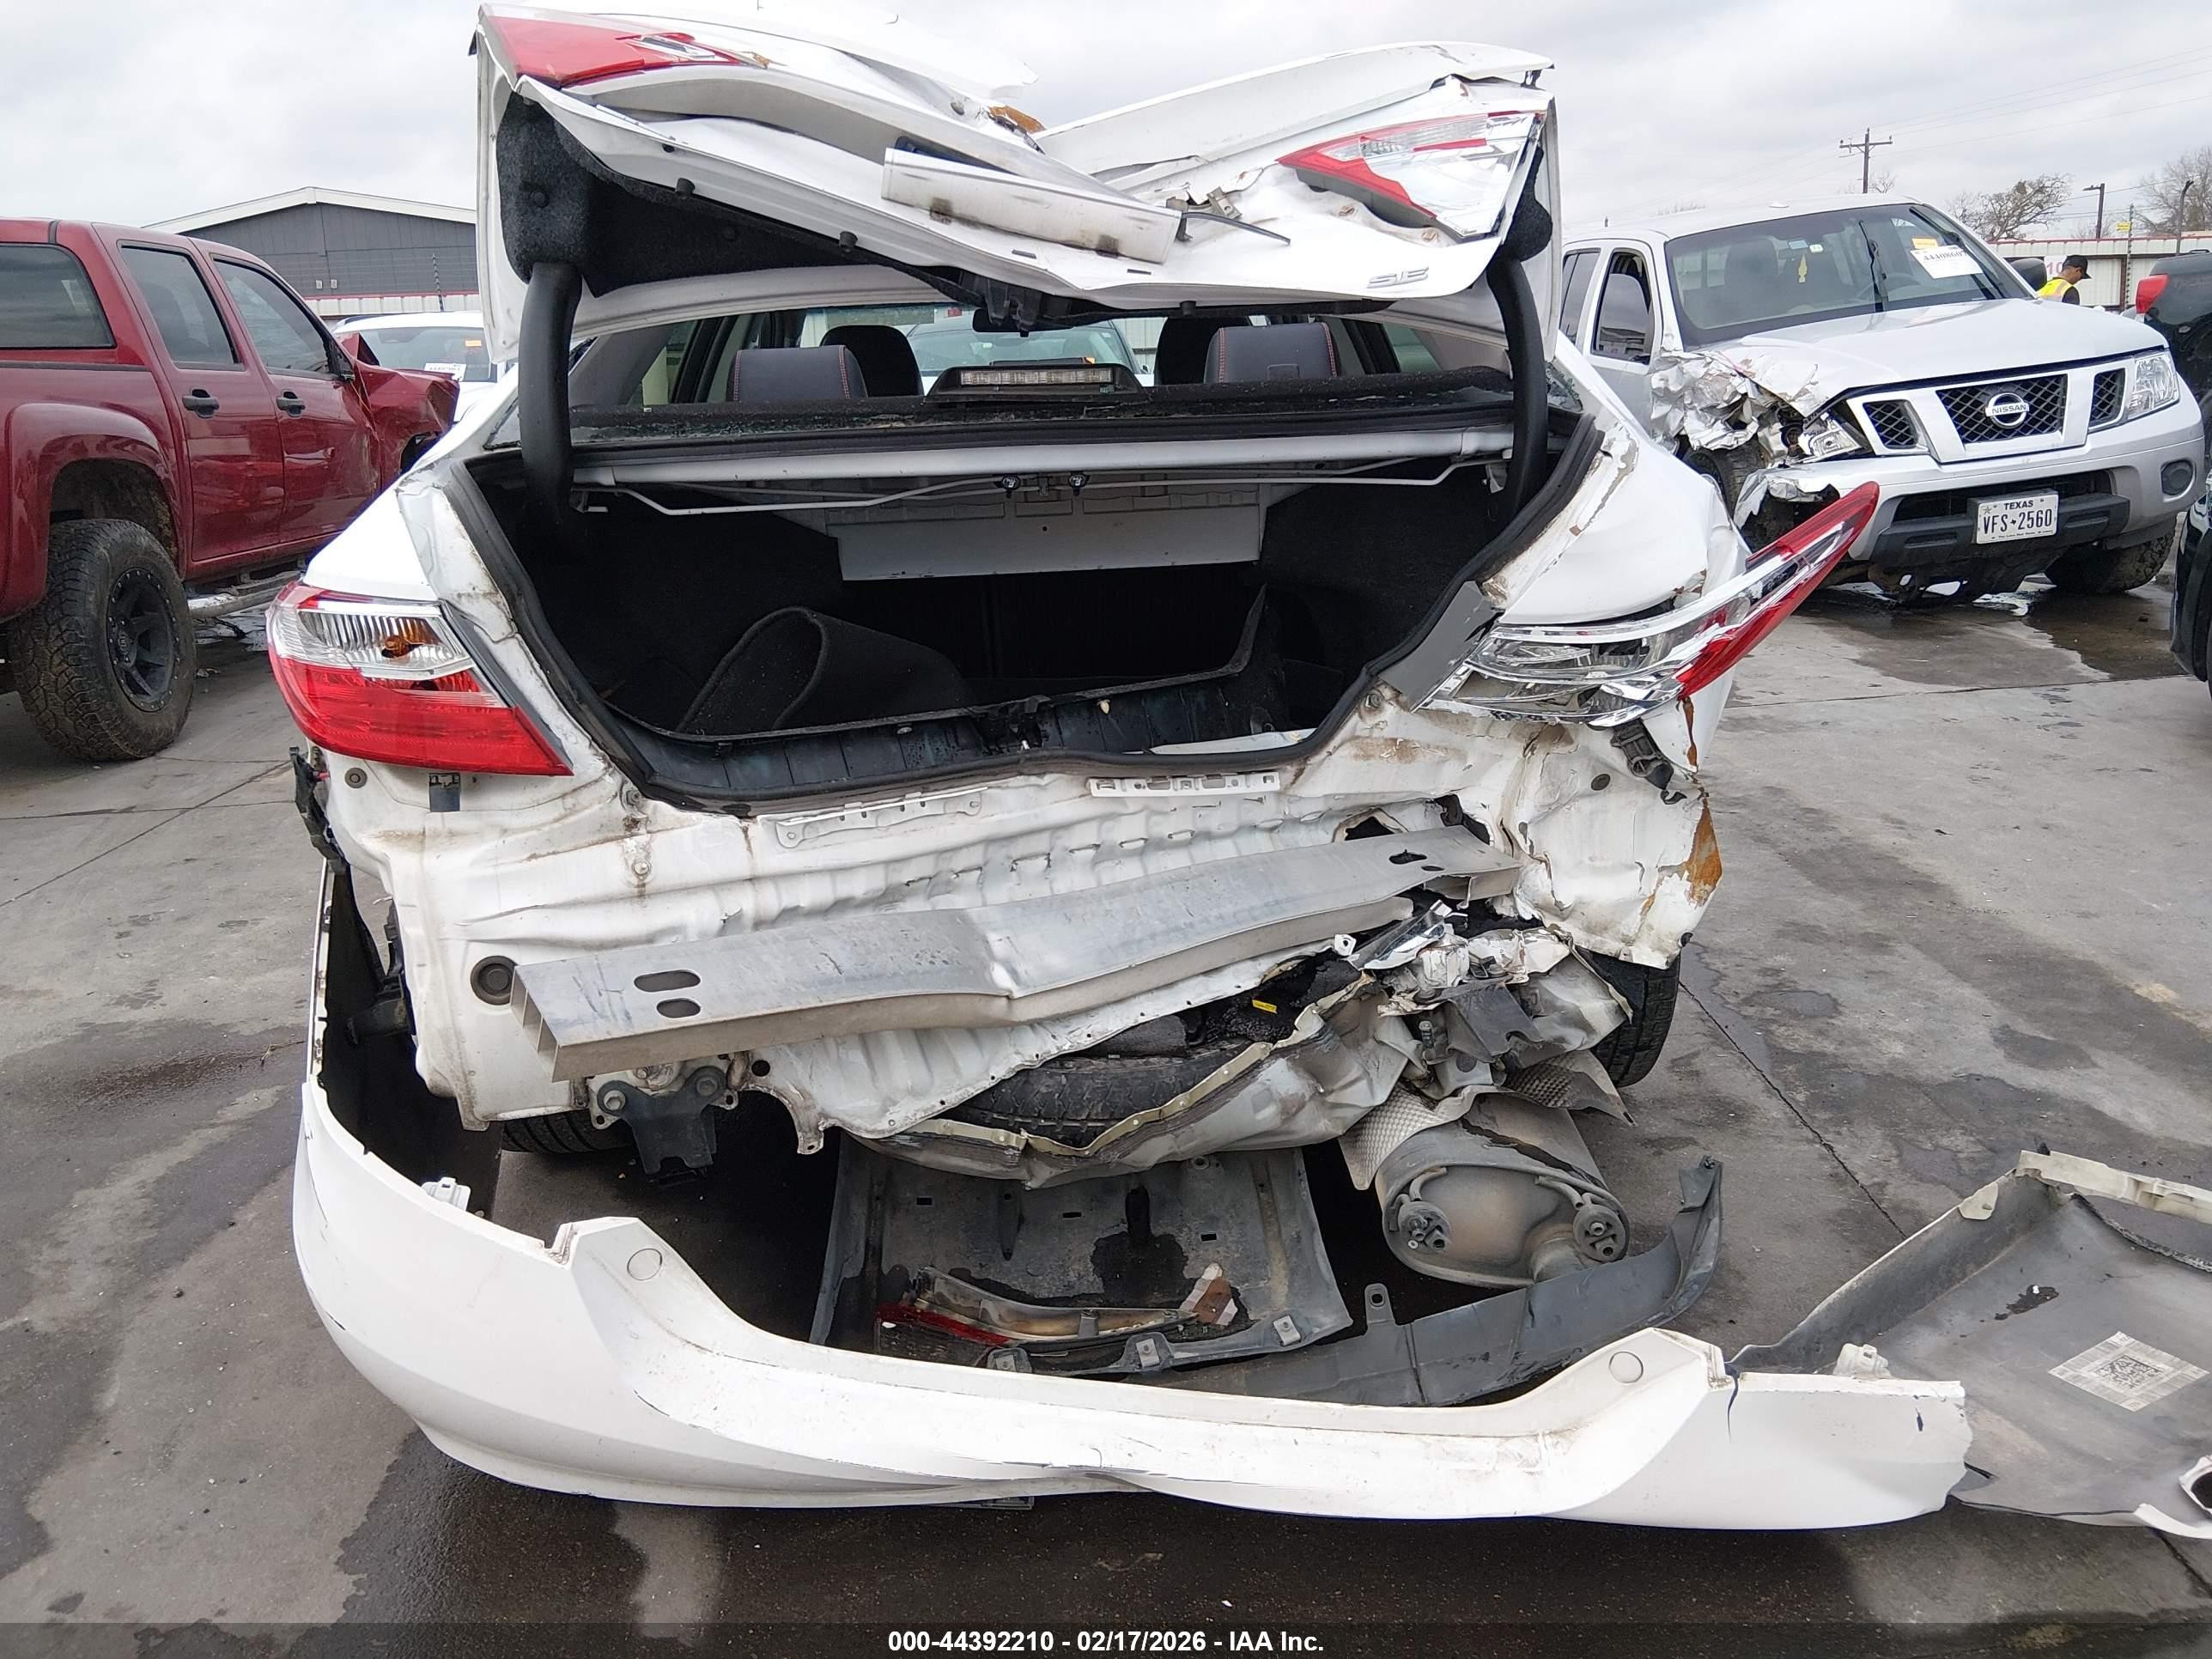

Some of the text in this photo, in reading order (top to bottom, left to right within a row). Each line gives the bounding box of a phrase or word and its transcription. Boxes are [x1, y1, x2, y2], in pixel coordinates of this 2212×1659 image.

[1992, 404, 2027, 414] NISSAN
[2004, 500, 2034, 510] TEXAS
[1983, 514, 2008, 535] VFS
[2017, 508, 2053, 531] 2560
